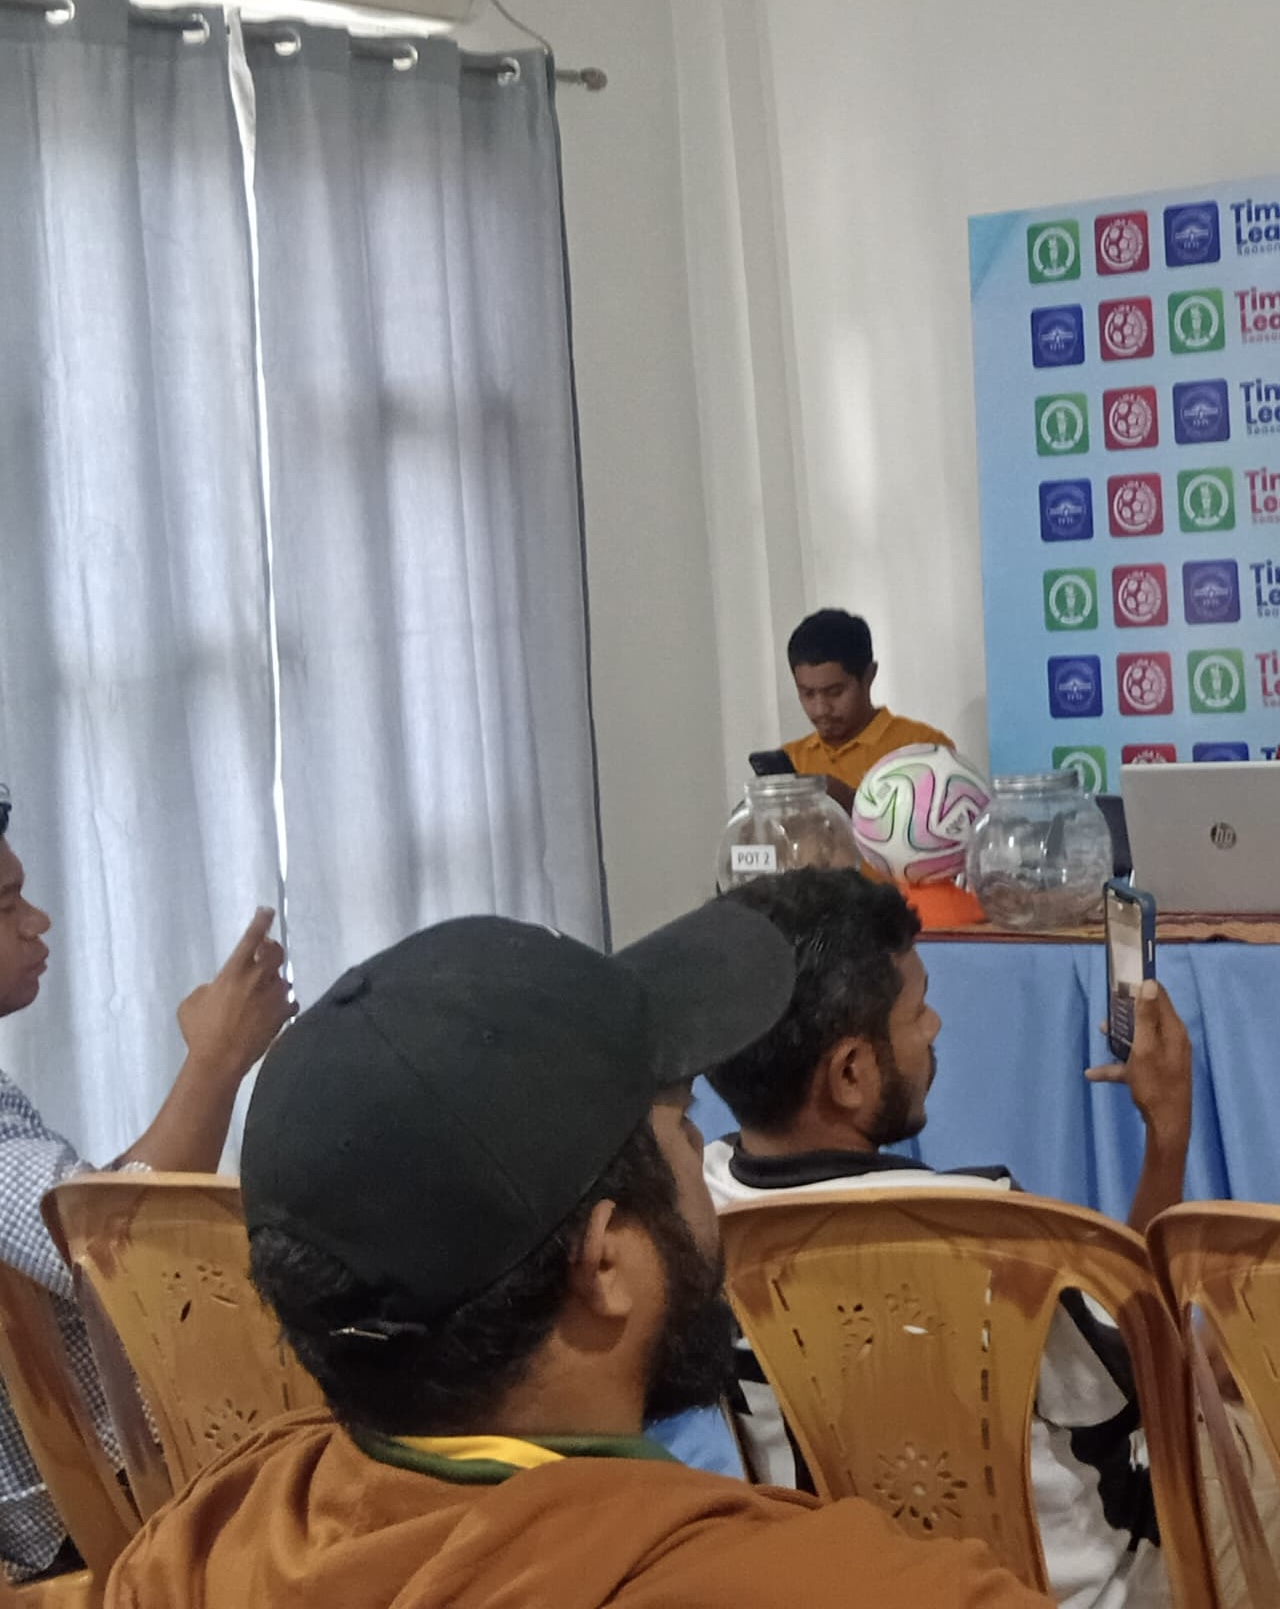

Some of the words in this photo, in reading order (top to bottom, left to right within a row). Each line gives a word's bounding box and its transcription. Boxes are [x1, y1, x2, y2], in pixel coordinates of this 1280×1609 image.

[1214, 822, 1234, 849] hp
[737, 851, 760, 866] POT
[763, 851, 770, 866] 2
